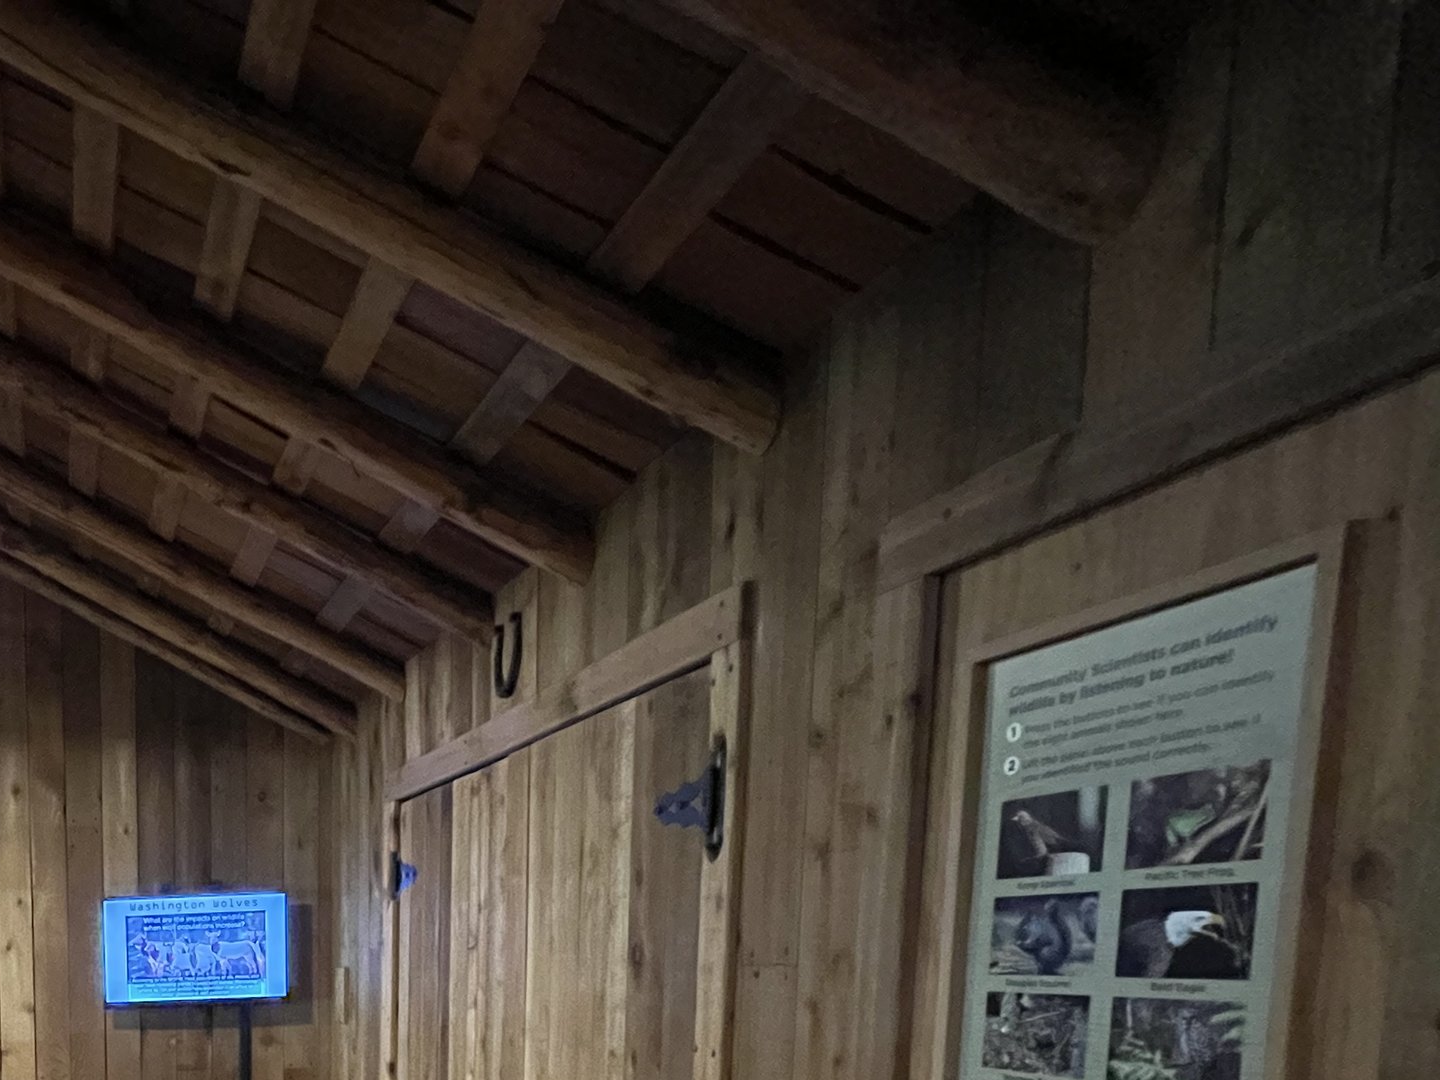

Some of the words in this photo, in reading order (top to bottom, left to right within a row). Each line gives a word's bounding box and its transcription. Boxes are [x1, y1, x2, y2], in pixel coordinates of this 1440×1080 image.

[1008, 696, 1055, 718] wildlife
[1058, 690, 1078, 705] by
[1079, 674, 1145, 700] listening
[1149, 669, 1167, 682] to
[1170, 648, 1235, 676] nature!
[1009, 669, 1087, 698] Community
[1091, 647, 1166, 676] Scientists
[1169, 638, 1201, 656] can
[1205, 614, 1279, 645] identify
[129, 899, 206, 913] Washington
